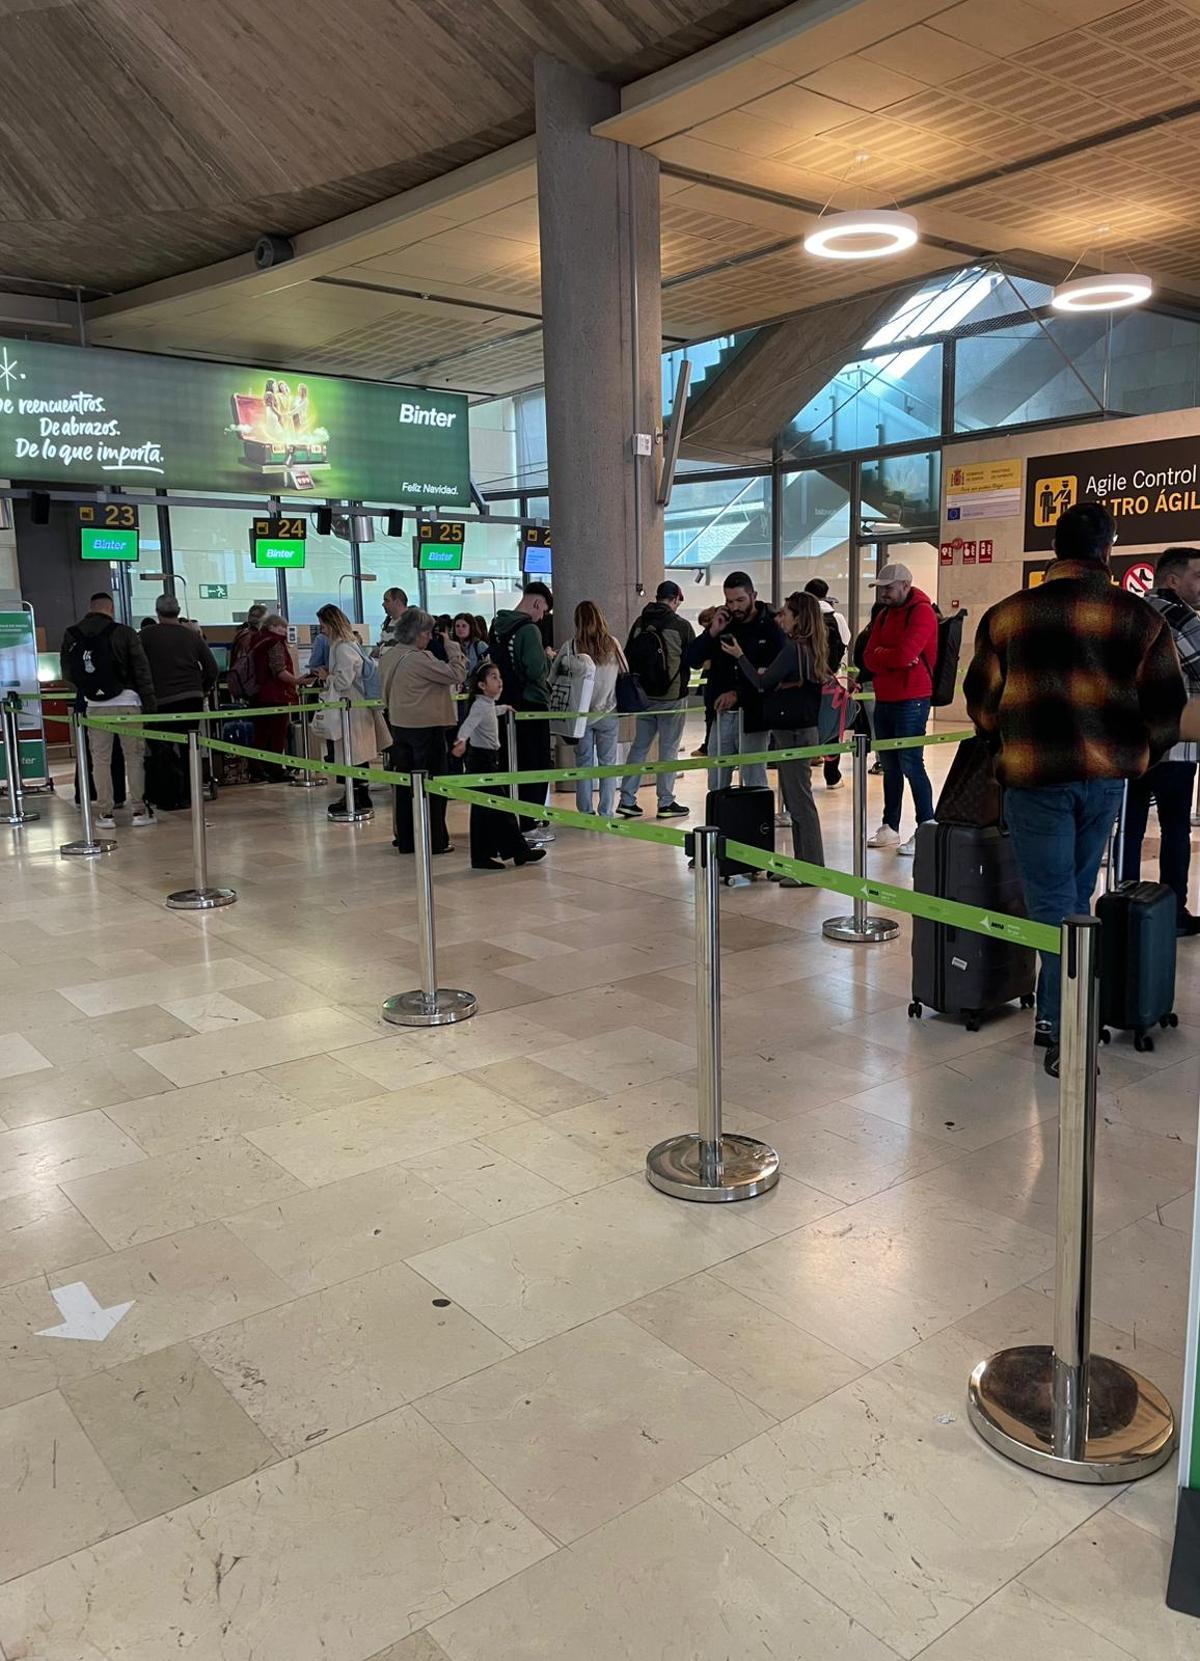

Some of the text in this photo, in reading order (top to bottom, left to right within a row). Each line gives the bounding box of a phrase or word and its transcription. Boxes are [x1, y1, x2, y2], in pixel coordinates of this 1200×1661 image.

[18, 391, 106, 415] reencuentros.
[399, 403, 457, 428] Binter
[39, 416, 121, 437] De abrazos.
[15, 438, 165, 467] De lo que importa.
[402, 482, 459, 495] Feliz Navidad.
[1086, 464, 1197, 496] Agile Control
[1154, 489, 1200, 513] ÁGIL
[105, 505, 135, 526] 23
[278, 519, 304, 538] 24
[440, 524, 462, 542] 25
[93, 539, 127, 551] Binter
[266, 548, 295, 559] Binter
[428, 551, 453, 562] Binter
